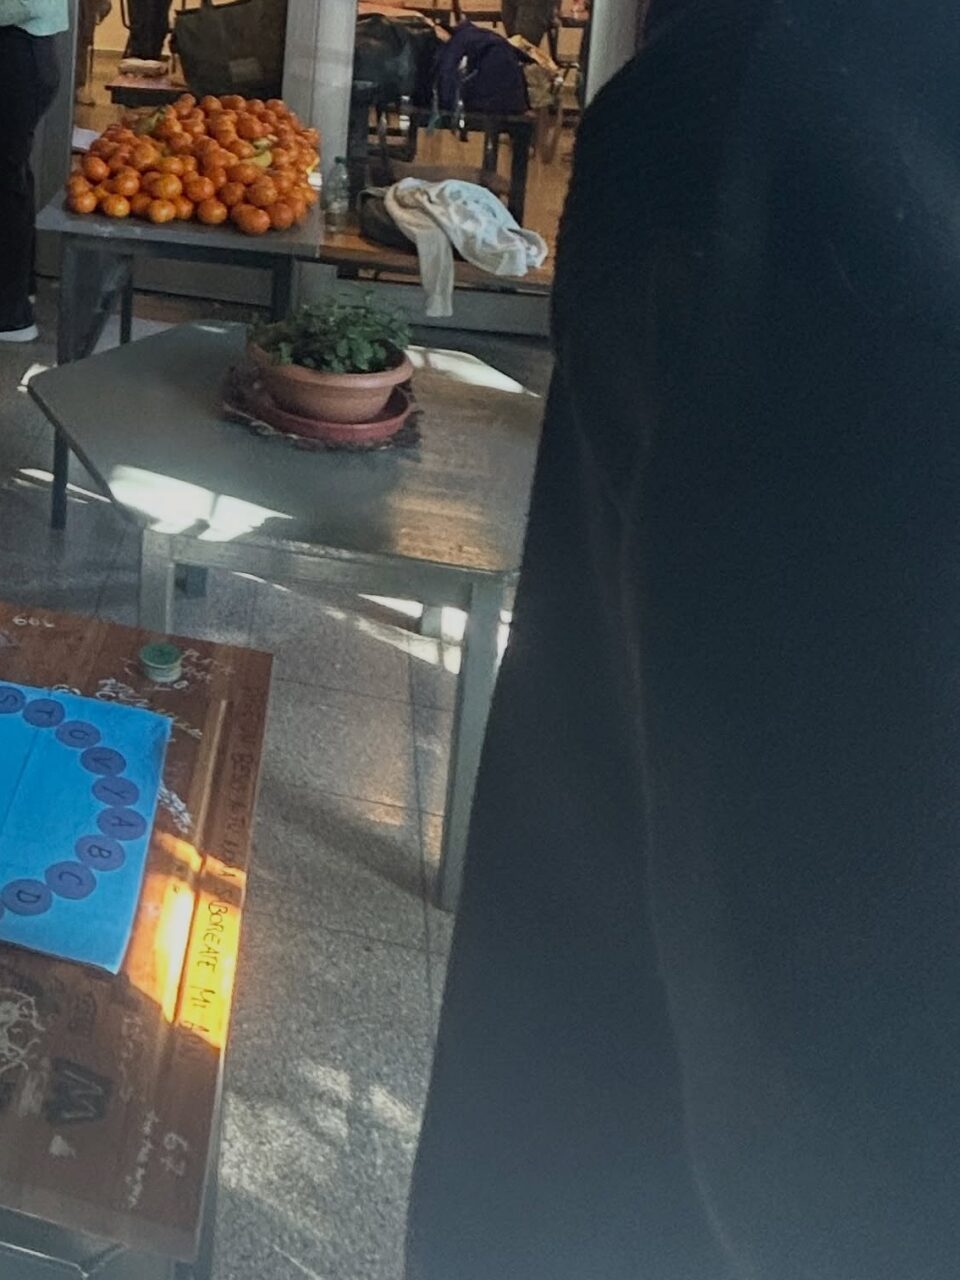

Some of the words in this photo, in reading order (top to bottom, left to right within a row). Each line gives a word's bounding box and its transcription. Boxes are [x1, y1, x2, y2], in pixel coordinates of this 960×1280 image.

[69, 729, 89, 740] U
[92, 757, 112, 769] V
[101, 786, 128, 799] Y
[111, 815, 135, 827] A
[87, 844, 112, 859] B
[58, 871, 82, 887] C
[16, 889, 40, 903] D
